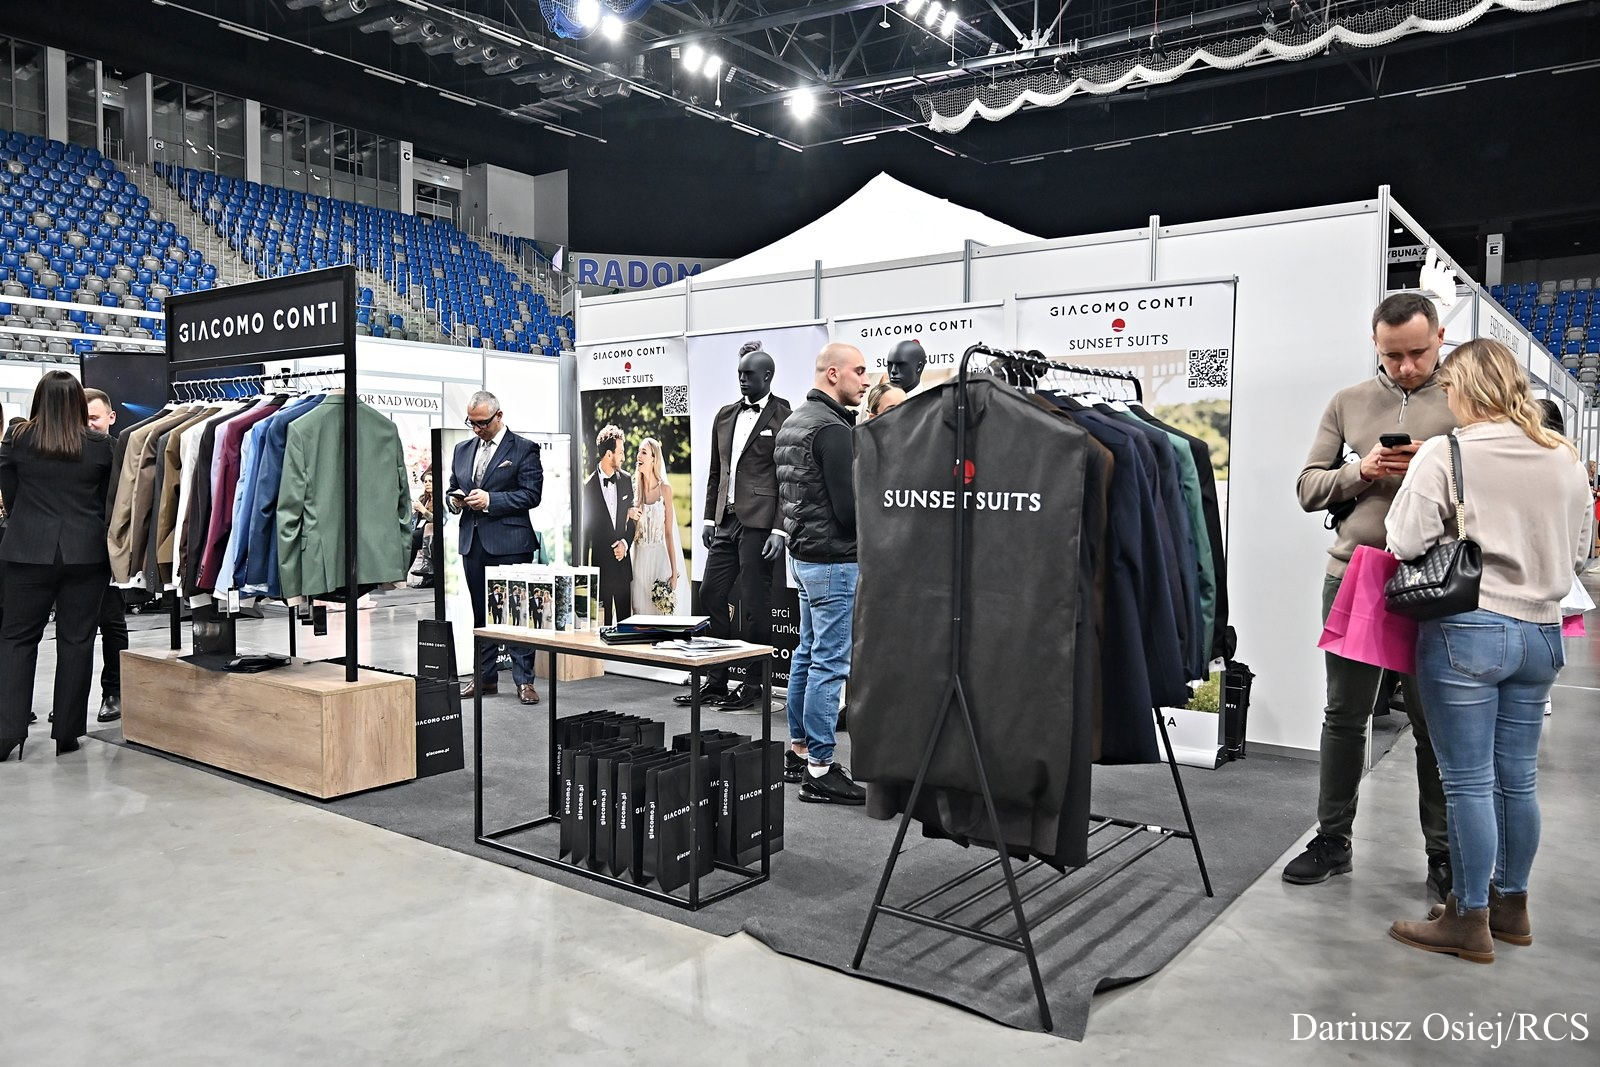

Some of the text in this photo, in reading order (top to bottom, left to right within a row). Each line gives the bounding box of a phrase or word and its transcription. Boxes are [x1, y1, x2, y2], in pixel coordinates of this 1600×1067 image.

[403, 152, 411, 161] C
[1489, 245, 1499, 255] E
[578, 258, 703, 288] RADOM
[1049, 295, 1193, 317] GIACOMO CONTI
[178, 301, 337, 343] GIACOMO CONTI
[860, 318, 973, 338] GIACOMO CONTI
[1069, 334, 1169, 351] SUNSET SUITS
[592, 346, 666, 360] GIACOMO CONTI
[602, 373, 654, 386] SUNSET SUITS
[378, 395, 402, 406] NAD
[404, 396, 439, 411] WODĄ
[976, 491, 1041, 512] SUITS
[722, 780, 730, 816] giacomo.pl
[739, 781, 783, 801] GIACOM ONTI
[648, 801, 656, 840] giacomo.pl
[663, 805, 690, 821] GIACOMO
